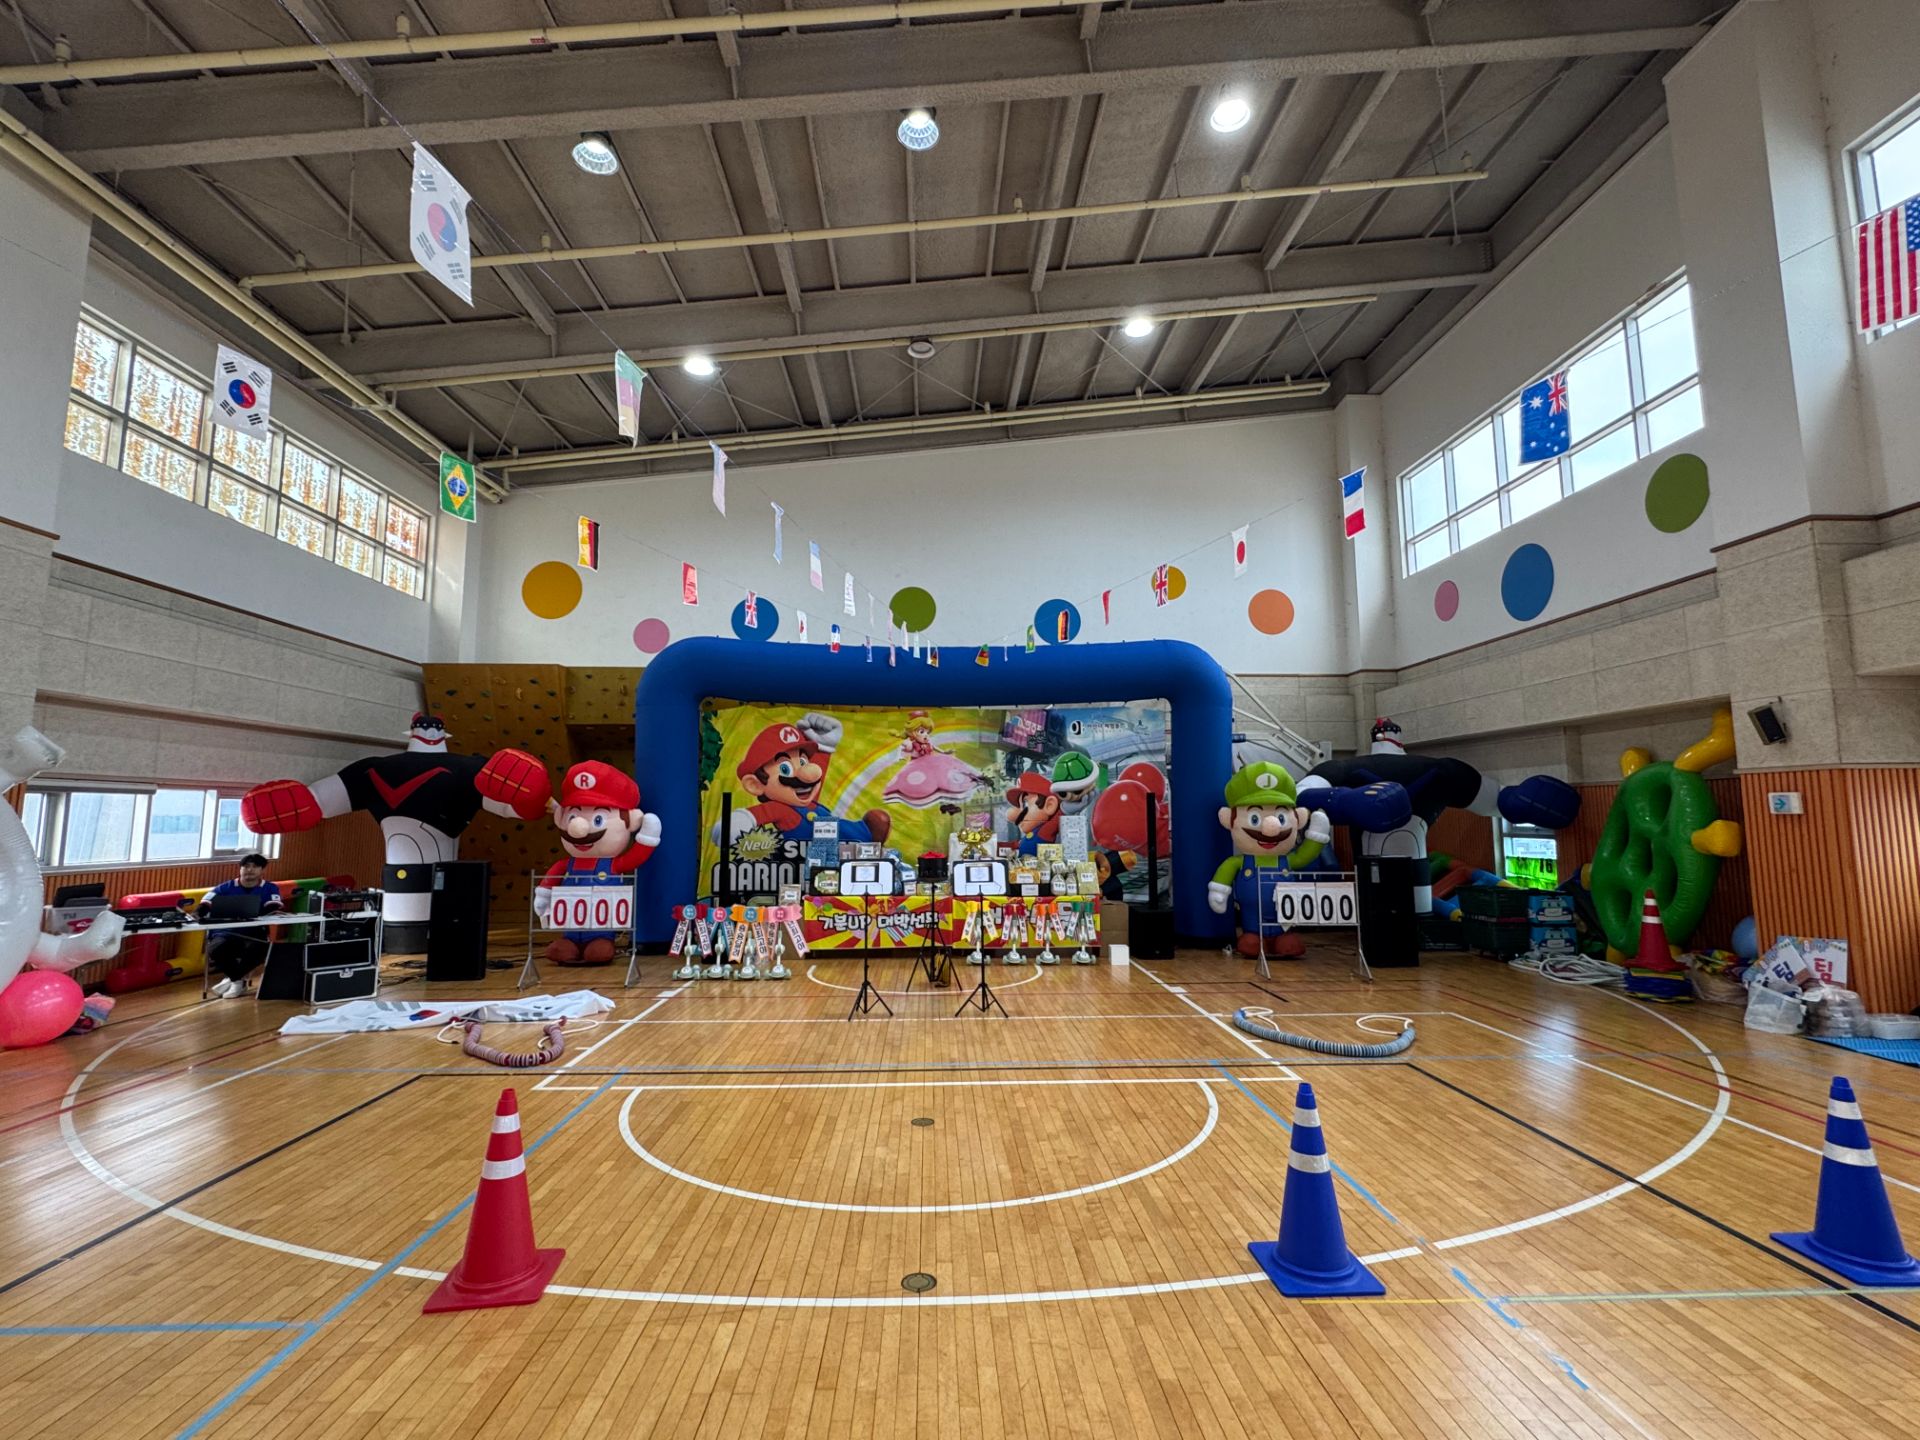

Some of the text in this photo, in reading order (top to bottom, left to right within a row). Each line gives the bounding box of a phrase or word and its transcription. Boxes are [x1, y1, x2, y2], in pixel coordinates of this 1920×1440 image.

[580, 774, 589, 787] R
[742, 840, 774, 852] New
[713, 862, 794, 892] MARIO
